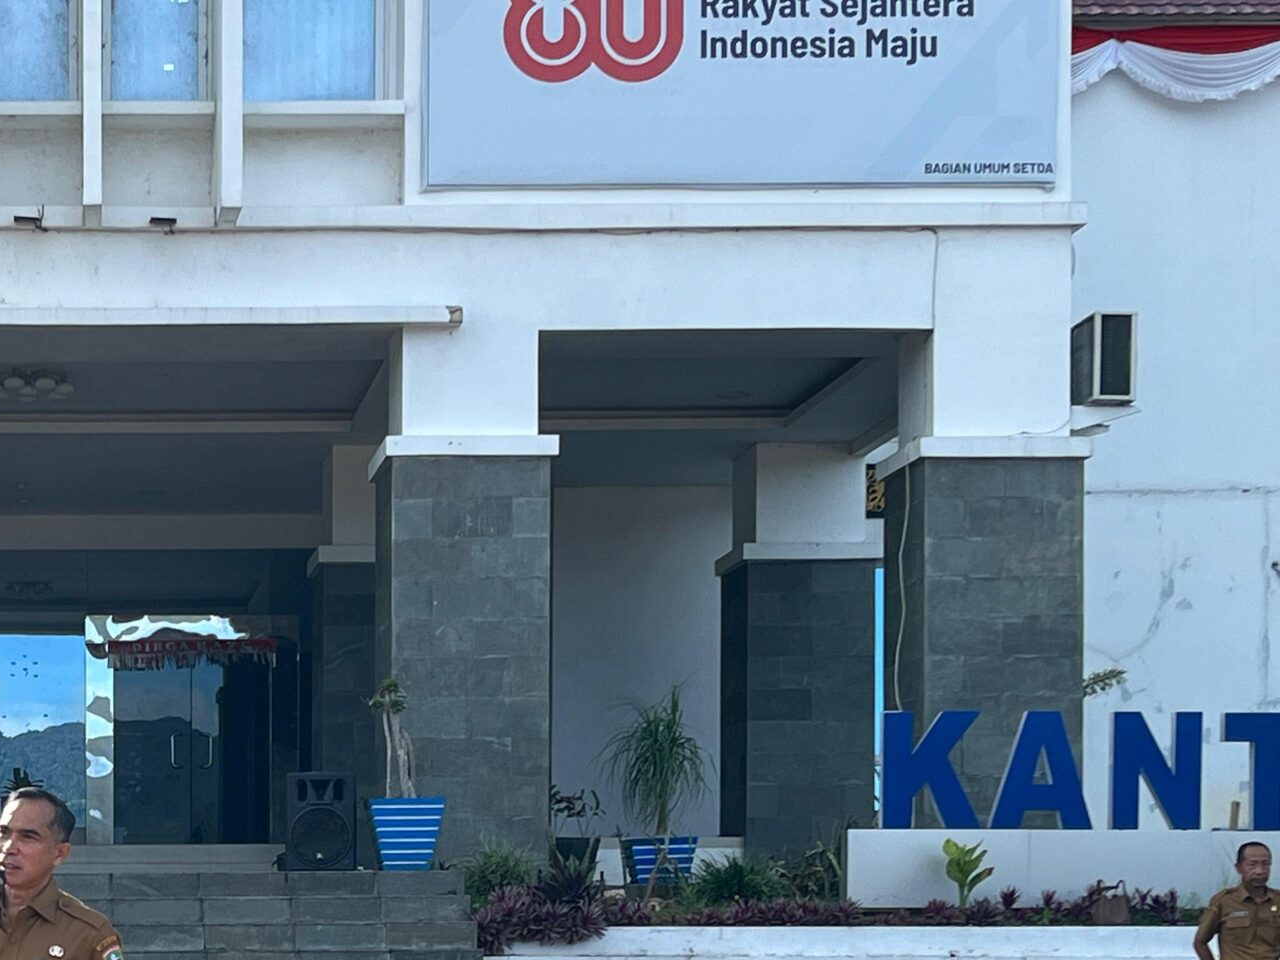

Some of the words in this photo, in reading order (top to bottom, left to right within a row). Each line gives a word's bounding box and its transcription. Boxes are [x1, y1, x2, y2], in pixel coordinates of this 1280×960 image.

[700, 0, 809, 25] Rakyat
[820, 0, 976, 25] Sejahtera
[700, 28, 856, 59] Indonesia
[865, 29, 938, 65] Maju
[924, 162, 971, 174] BAGIAN
[974, 162, 1011, 174] UMUM
[1013, 162, 1054, 174] SETDA
[881, 710, 1280, 829] KANT
